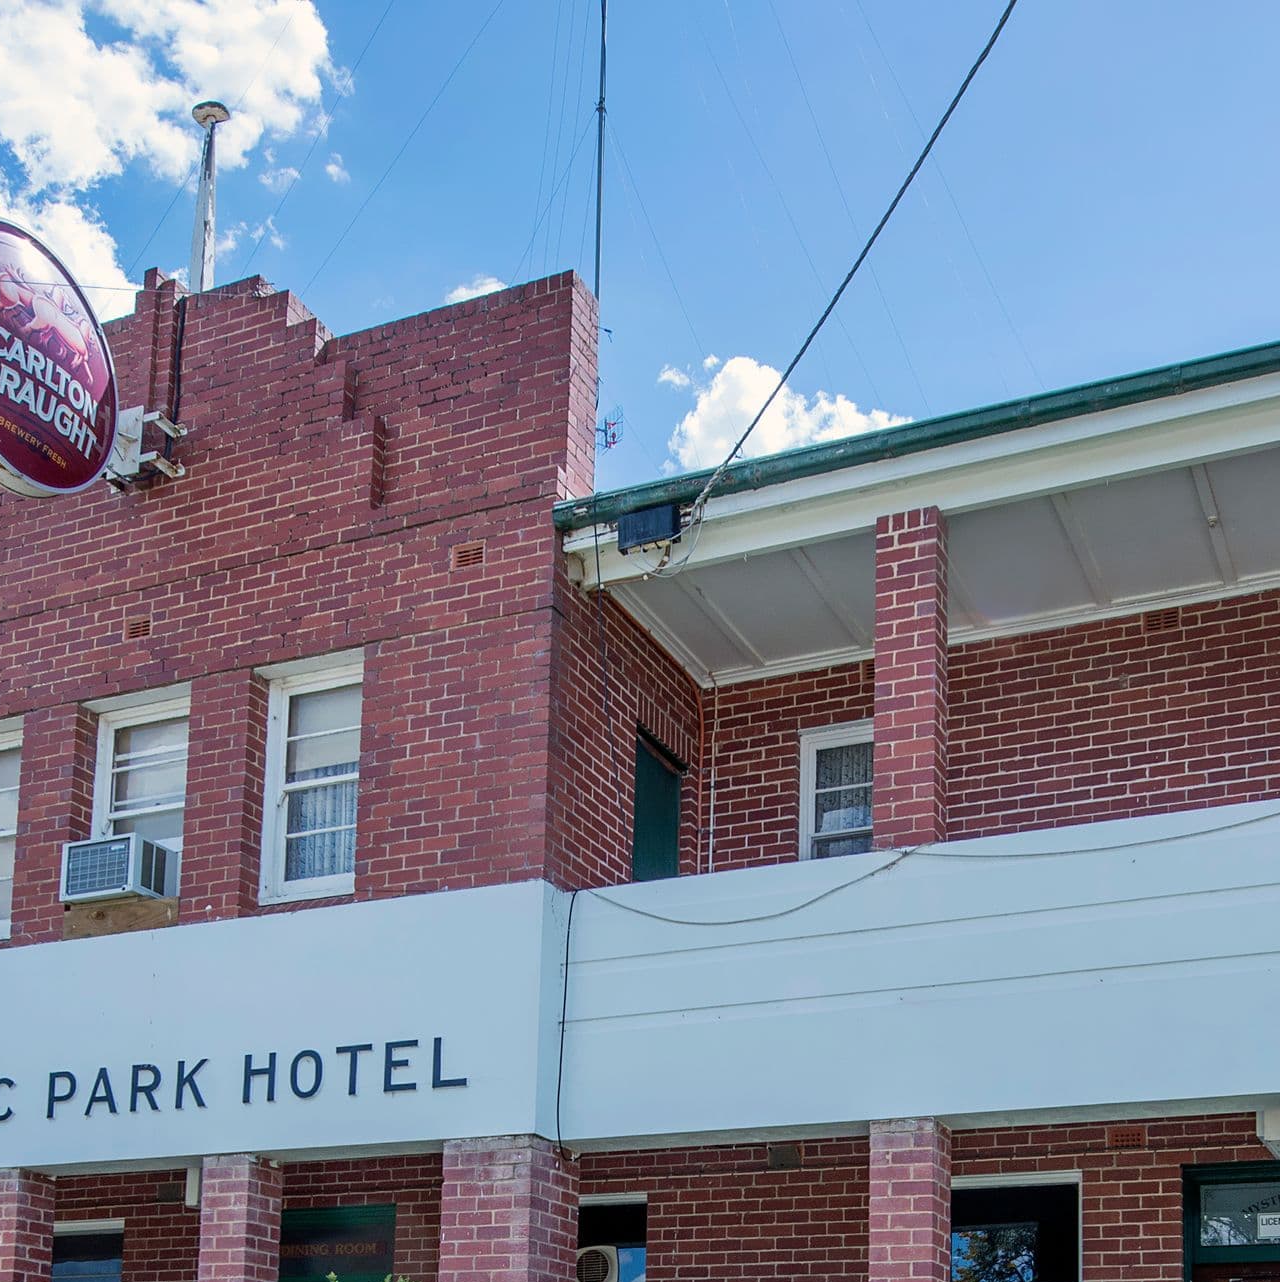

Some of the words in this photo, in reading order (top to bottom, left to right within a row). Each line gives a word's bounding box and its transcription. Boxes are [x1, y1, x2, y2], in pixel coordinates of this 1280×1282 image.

[41, 443, 67, 470] FRESH
[45, 1058, 211, 1120] PARK
[242, 1036, 468, 1105] HOTEL
[335, 1242, 377, 1255] ROOM
